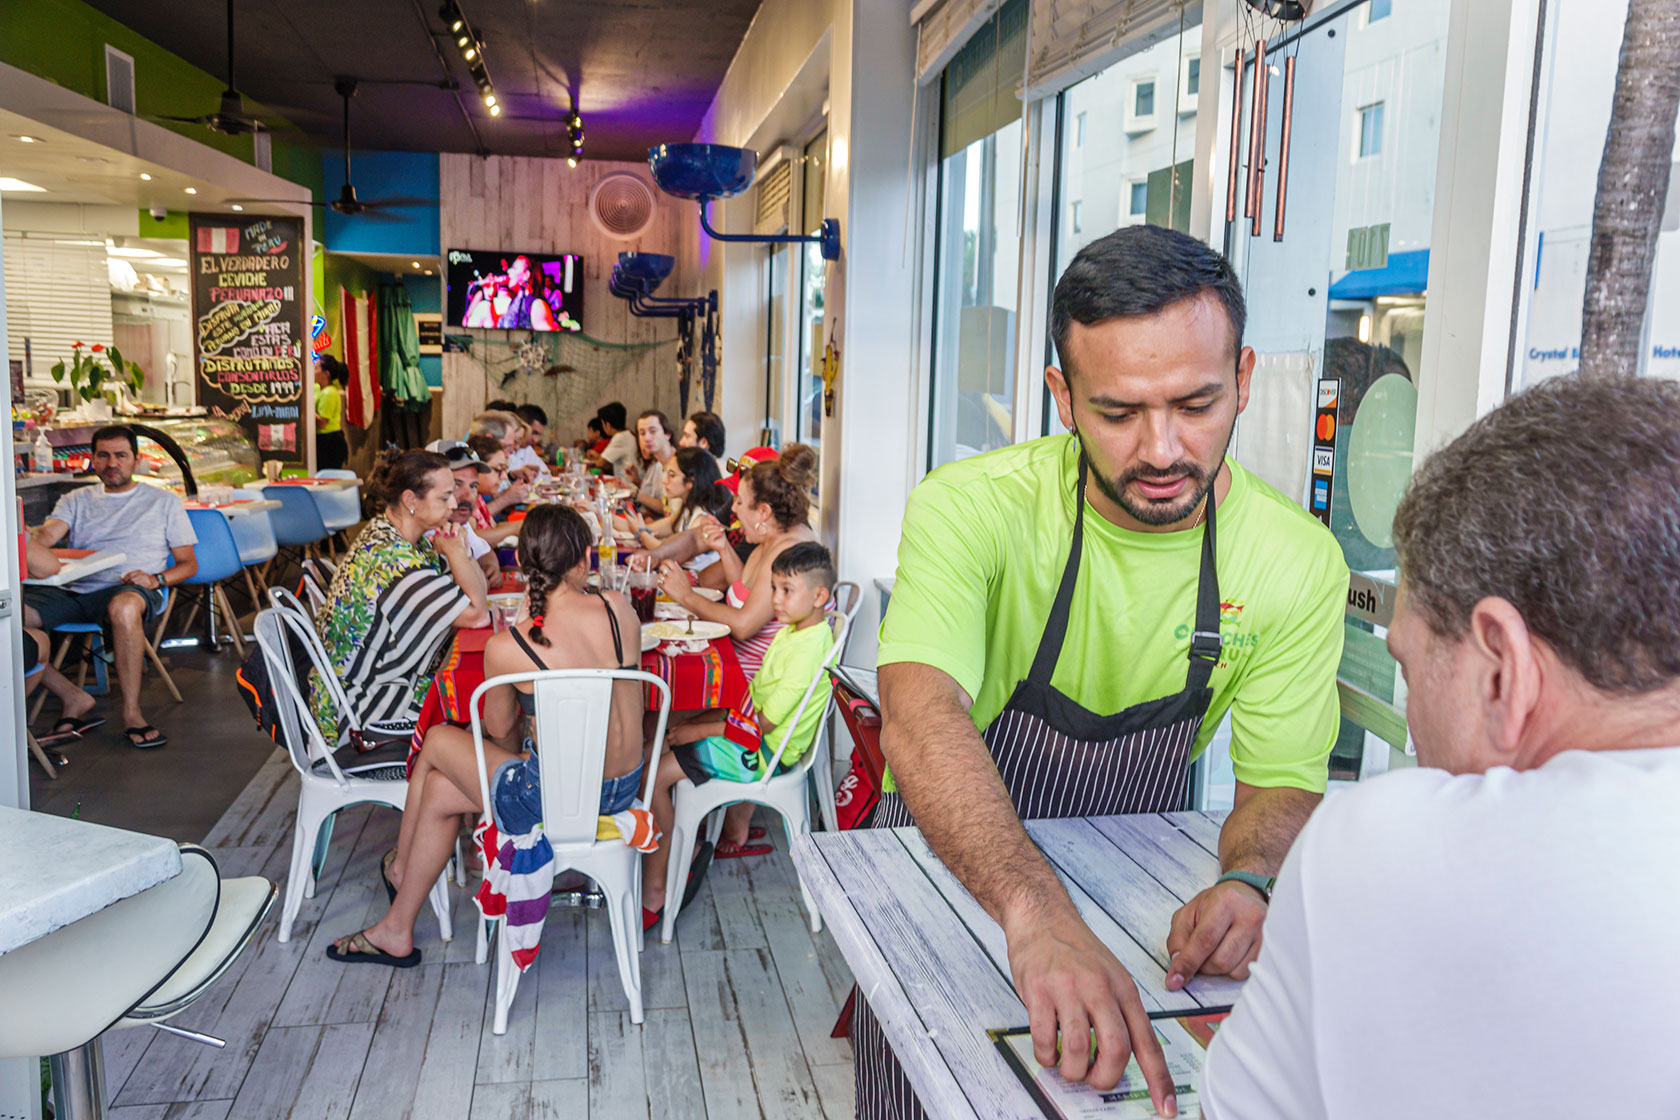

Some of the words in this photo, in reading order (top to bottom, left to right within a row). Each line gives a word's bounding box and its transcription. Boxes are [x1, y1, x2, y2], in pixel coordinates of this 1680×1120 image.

[245, 220, 273, 240] MADE
[201, 256, 219, 274] EL
[220, 255, 290, 272] VERDADERO
[218, 272, 267, 287] CEVICHE
[251, 334, 292, 347] ESTAS
[233, 345, 260, 359] COMO
[1529, 346, 1568, 363] Crystal
[230, 382, 268, 395] DESDE
[1317, 454, 1331, 466] VISA
[1348, 588, 1376, 614] ush
